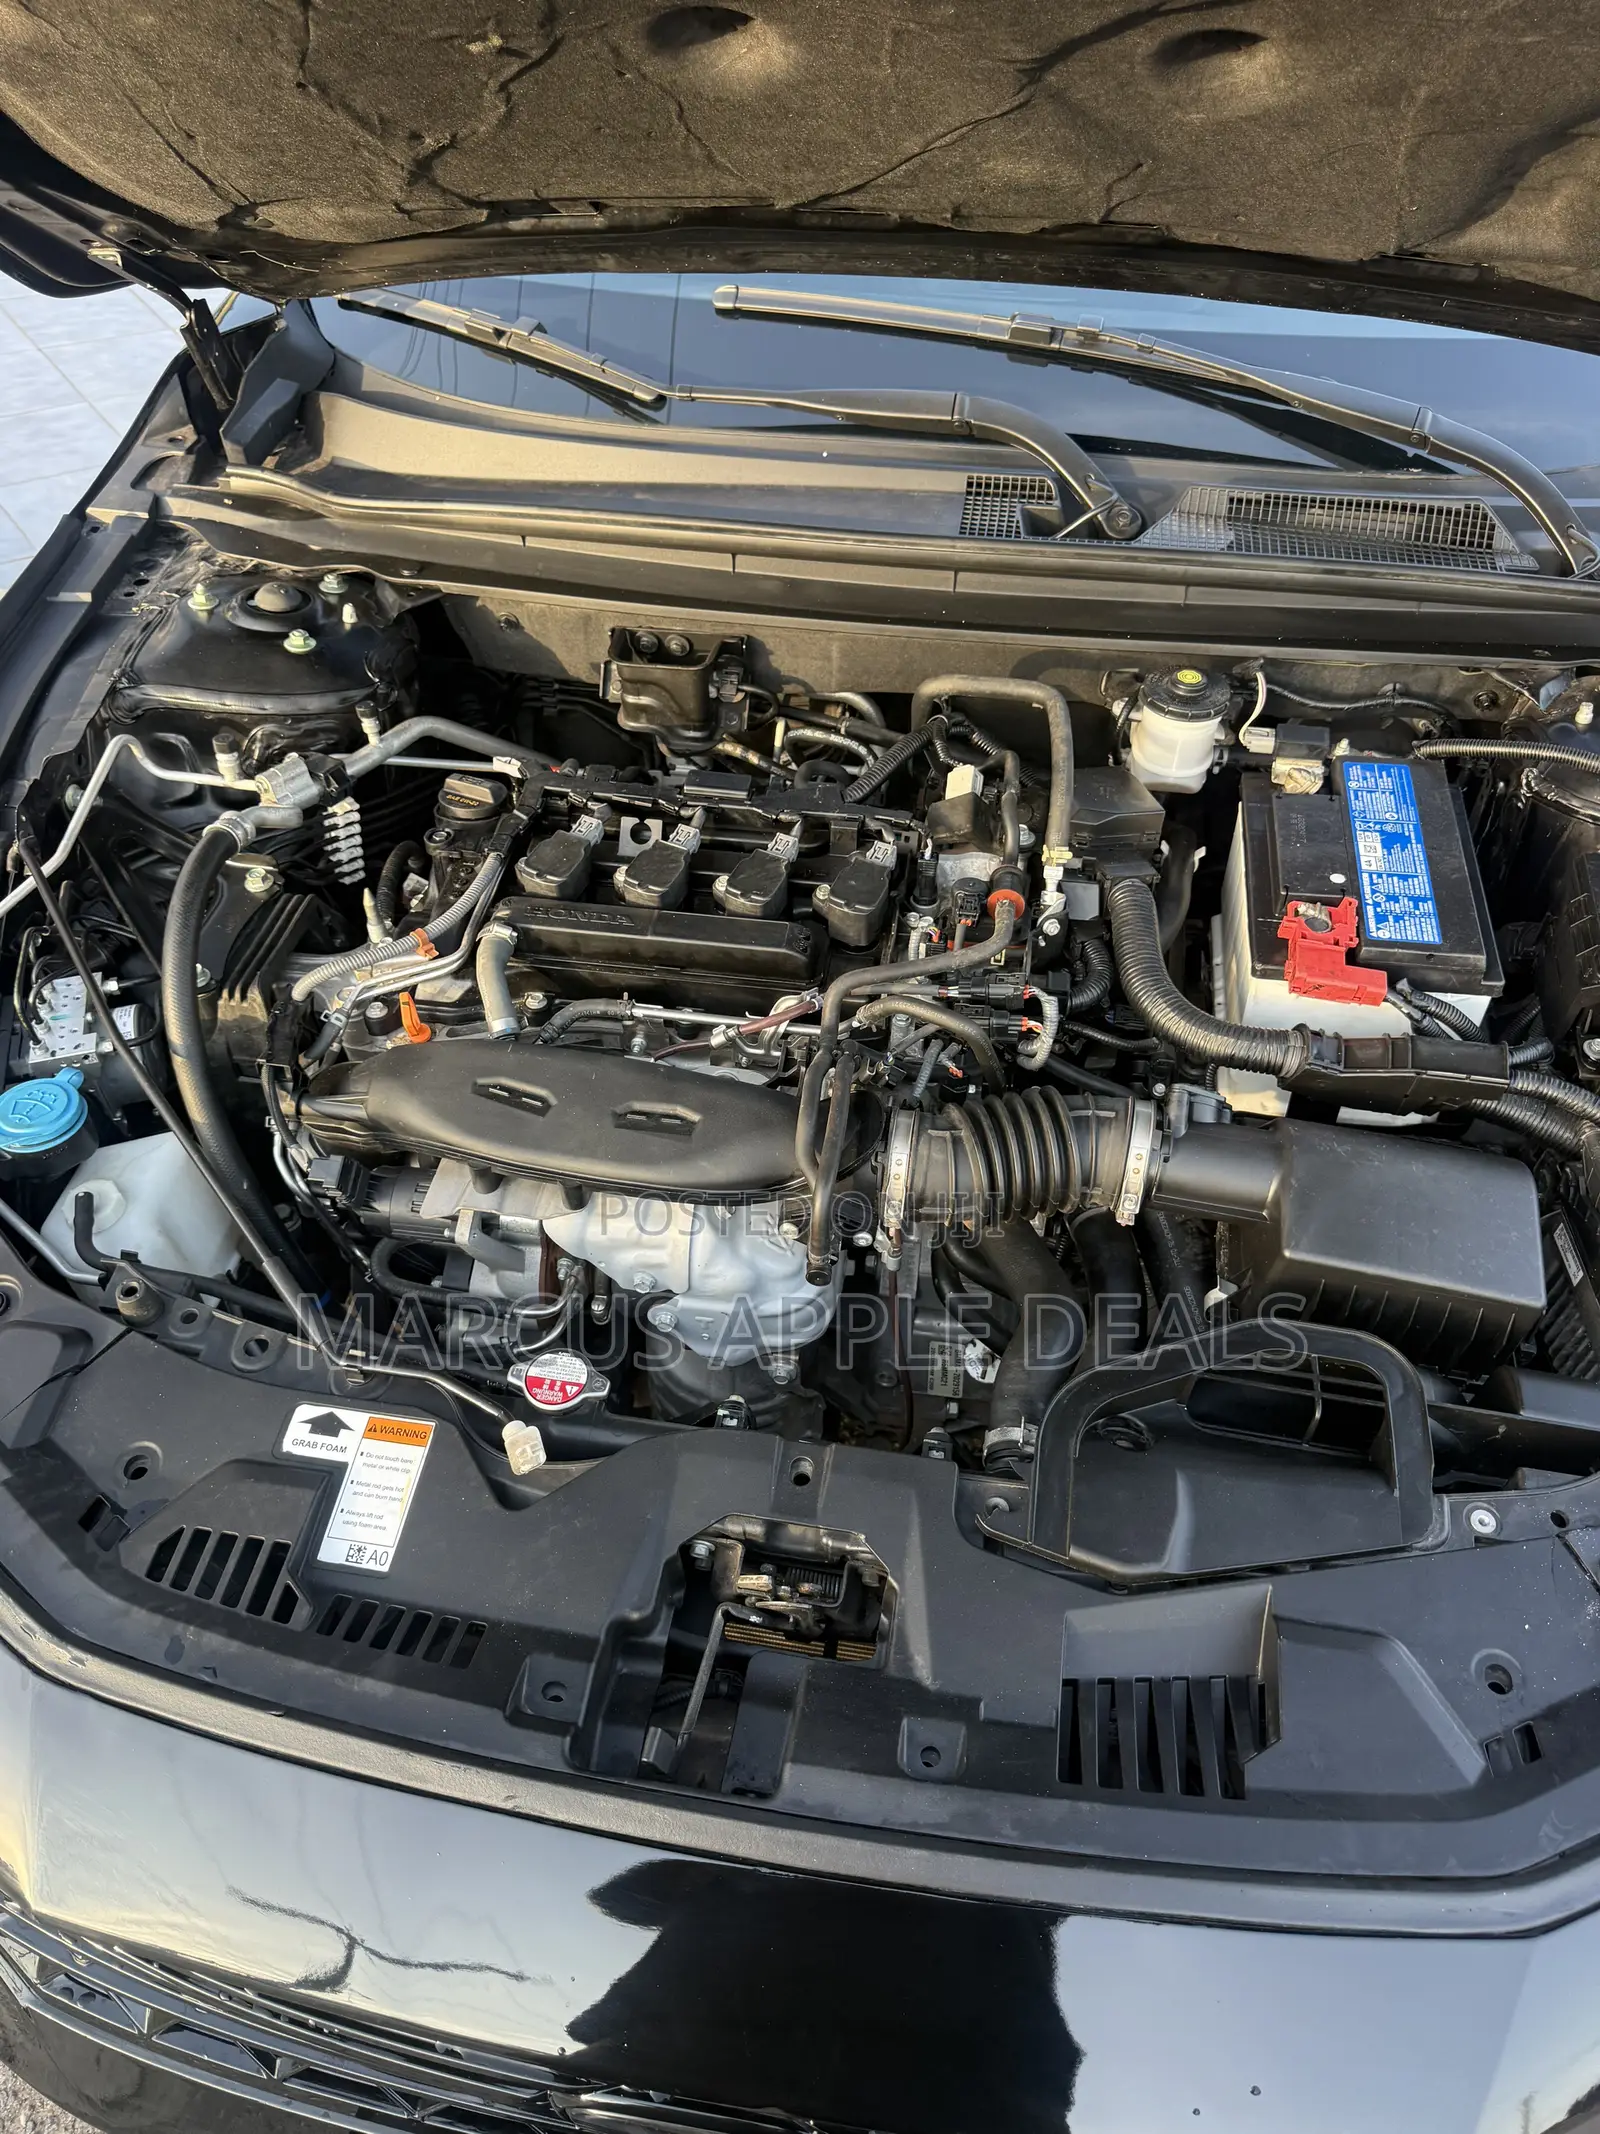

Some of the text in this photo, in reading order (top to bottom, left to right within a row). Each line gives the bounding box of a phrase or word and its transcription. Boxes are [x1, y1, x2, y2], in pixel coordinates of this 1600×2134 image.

[524, 906, 635, 926] HONDA
[379, 1425, 427, 1440] WARNING
[291, 1438, 348, 1453] GRAB FOAM
[374, 1453, 384, 1461] not
[384, 1454, 400, 1463] touch
[362, 1462, 378, 1470] metal
[385, 1464, 400, 1473] white
[355, 1480, 405, 1493] Metal rod gets hot
[375, 1492, 389, 1500] burn
[345, 1508, 365, 1519] Always
[365, 1511, 373, 1519] lift
[342, 1519, 357, 1528] using
[358, 1520, 373, 1529] foam
